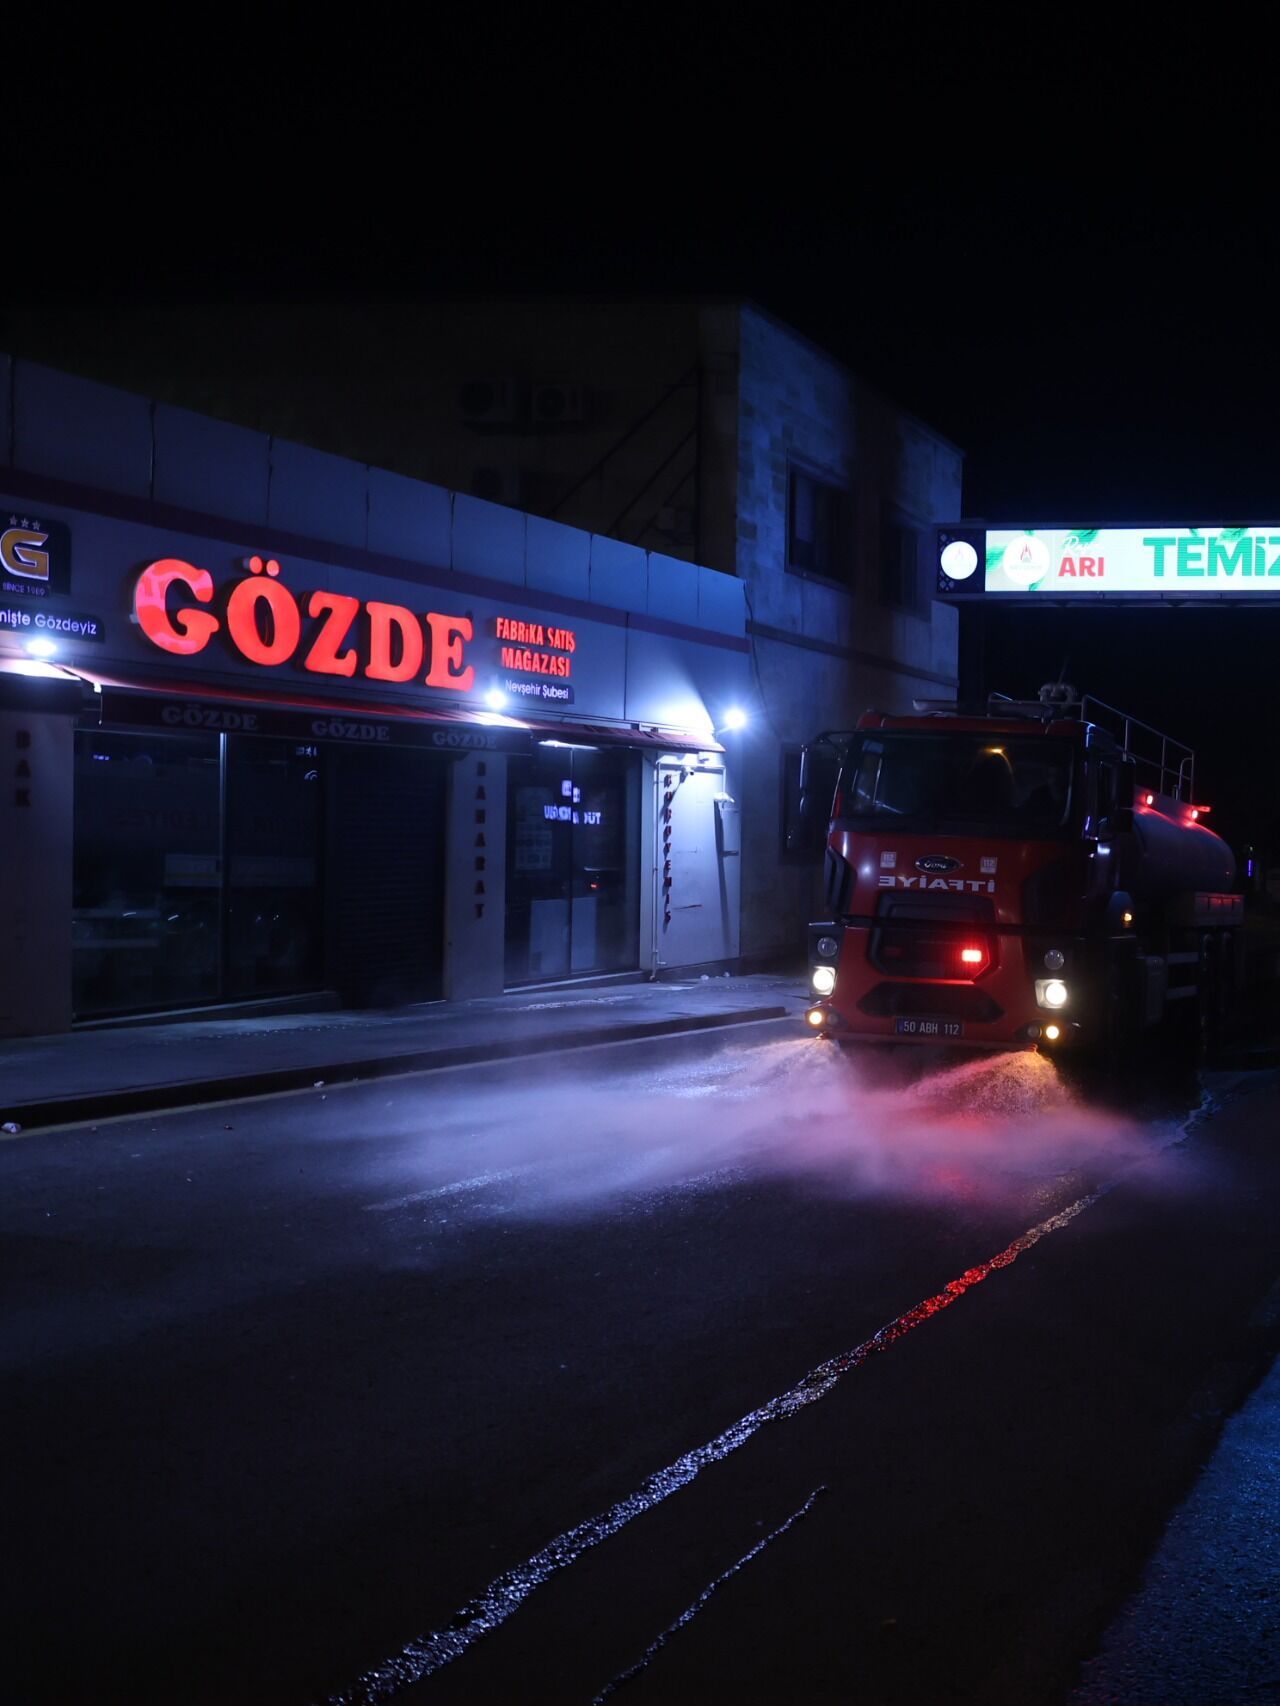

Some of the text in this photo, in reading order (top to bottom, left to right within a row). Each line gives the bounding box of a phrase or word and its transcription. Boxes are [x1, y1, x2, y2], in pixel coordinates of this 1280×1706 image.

[1058, 556, 1105, 578] ARI
[34, 613, 97, 636] Gözdeyiz
[134, 555, 475, 692] GÖZDE
[501, 646, 571, 678] MAĞAZASI
[160, 704, 259, 731] GÖZDE
[310, 718, 390, 742] GÖZDE
[431, 730, 497, 750] GÖZDE
[903, 1020, 960, 1036] 50 ABH 112
